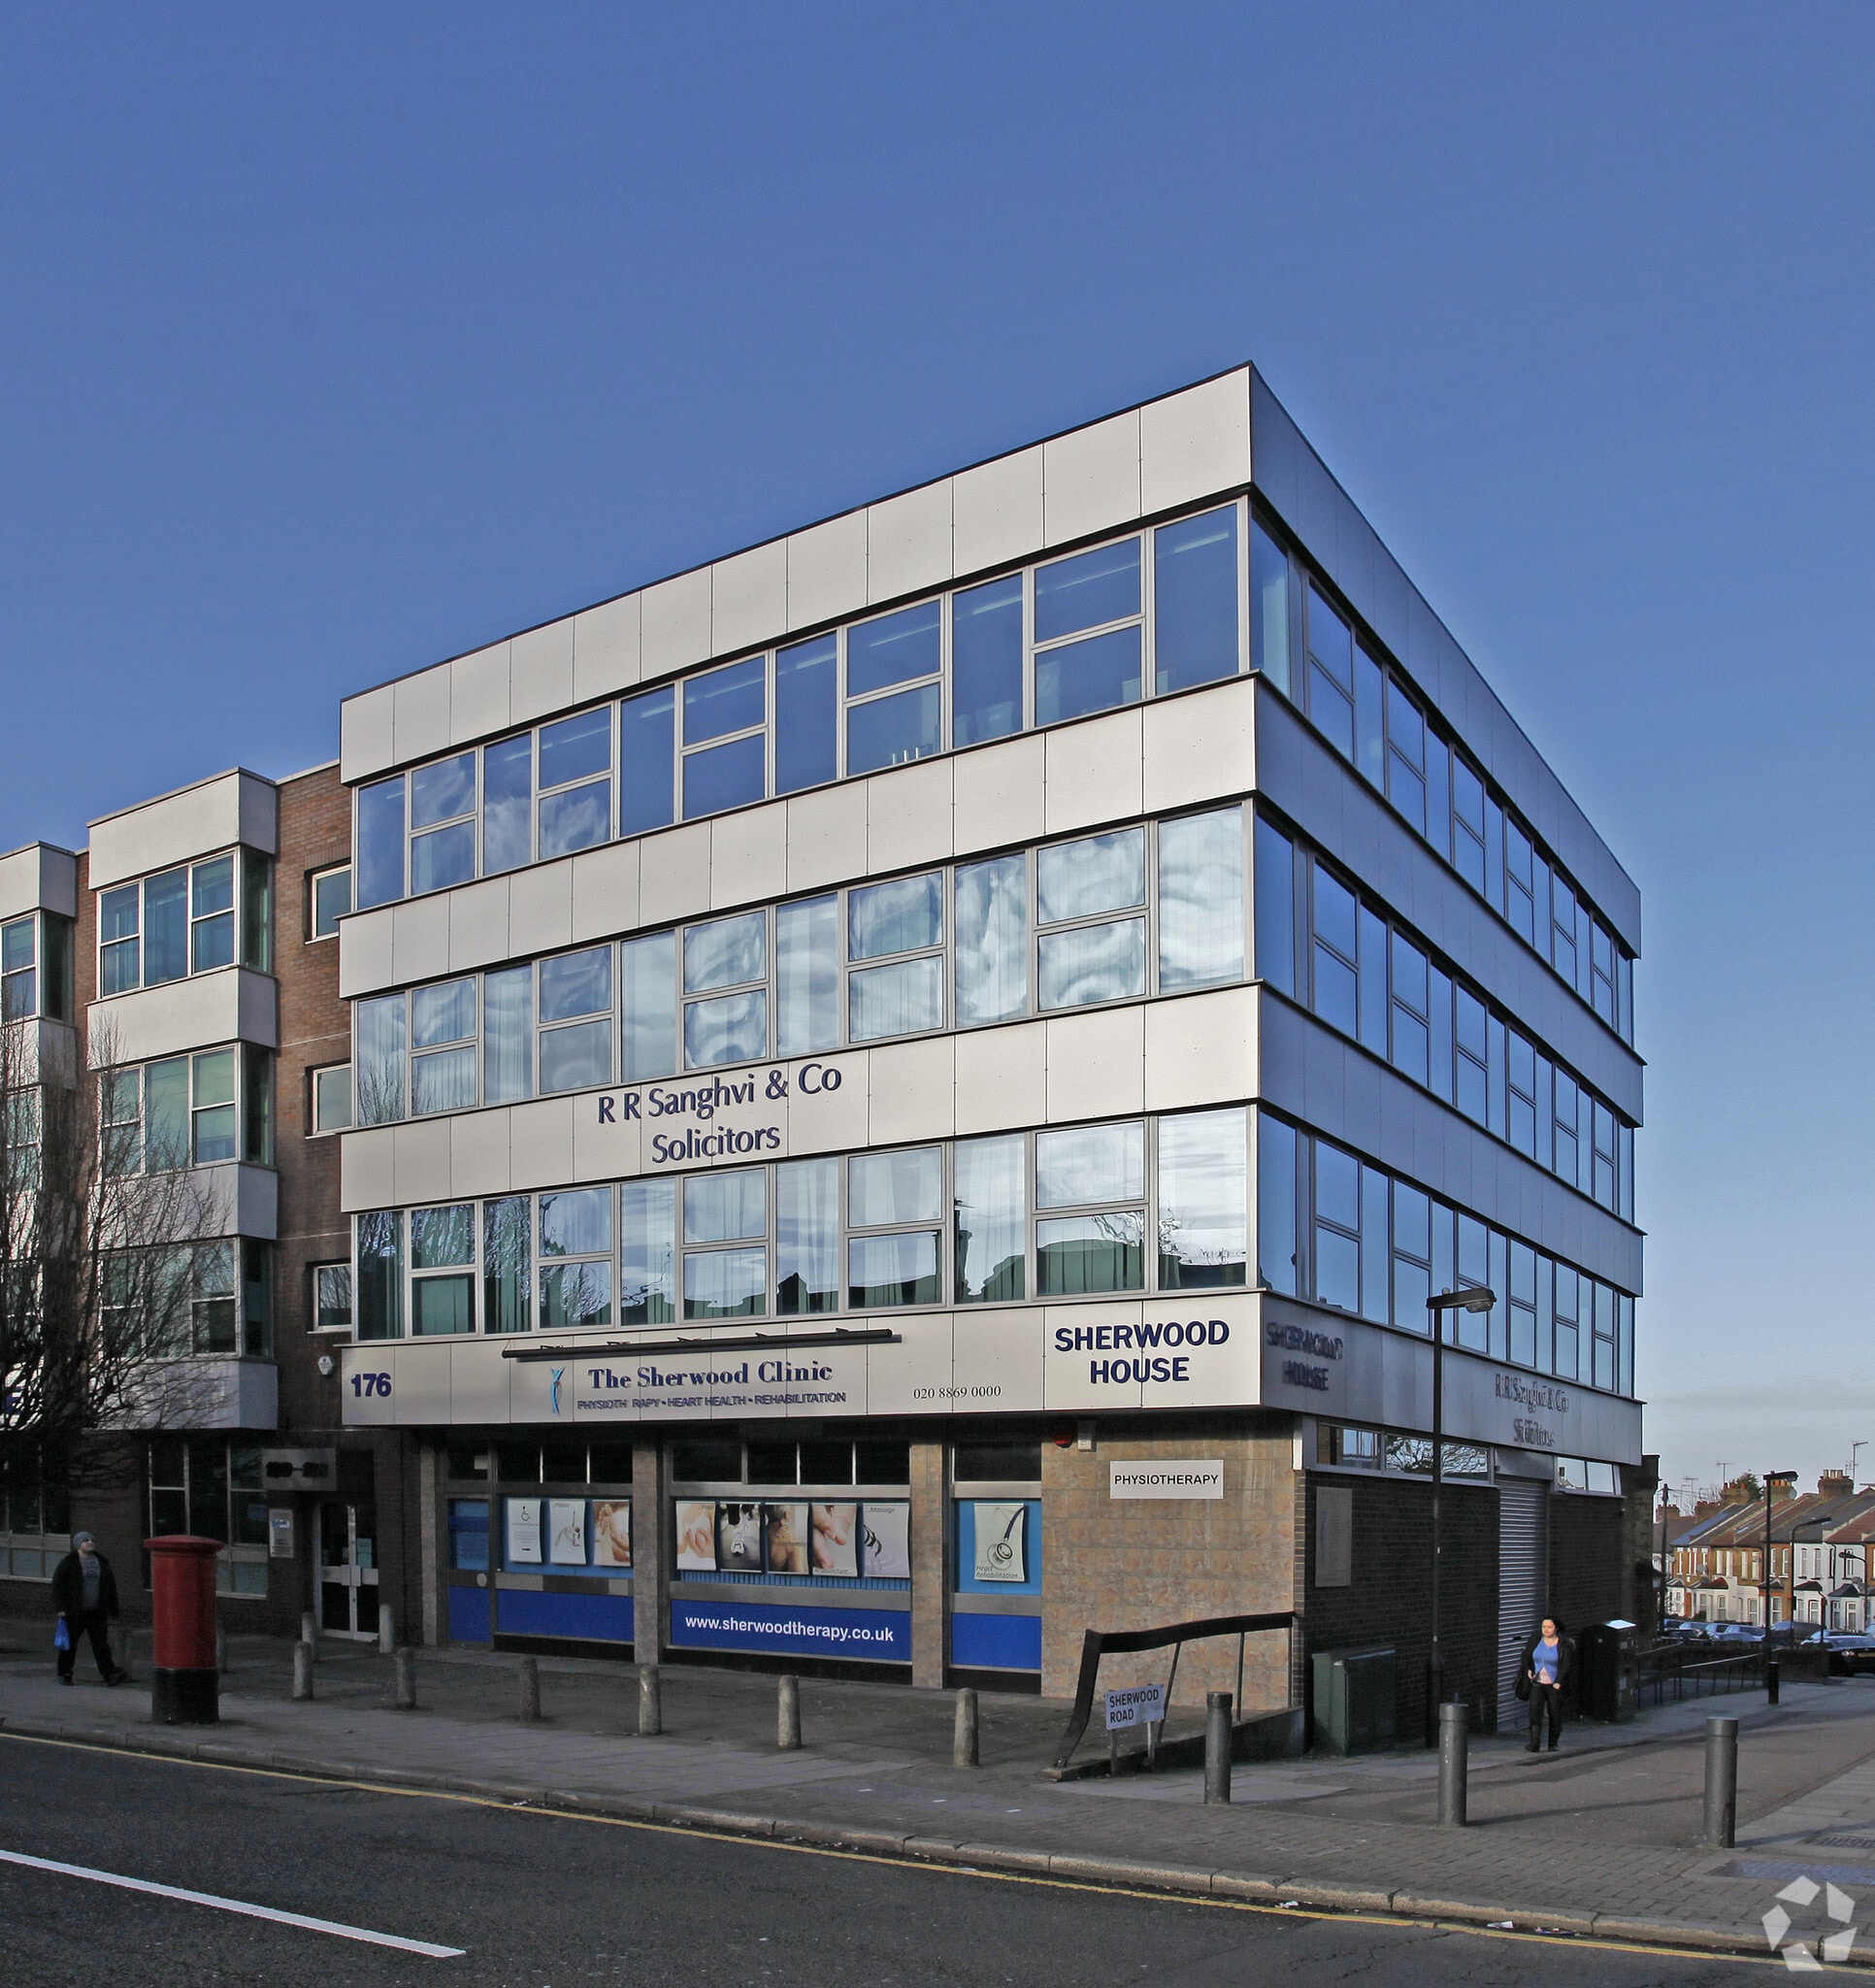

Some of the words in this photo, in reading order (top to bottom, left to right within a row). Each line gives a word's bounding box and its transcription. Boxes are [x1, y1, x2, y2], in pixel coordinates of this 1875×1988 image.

[598, 1096, 615, 1124] R
[623, 1092, 641, 1120] R
[648, 1074, 754, 1119] Sanghvi
[765, 1070, 789, 1100] &
[798, 1063, 842, 1095] Co
[651, 1125, 780, 1164] Solicitors
[1054, 1320, 1230, 1352] SHERWOOD
[588, 1368, 632, 1389] The
[637, 1362, 749, 1388] Sherwood
[758, 1360, 833, 1383] Clinic
[1090, 1356, 1190, 1384] HOUSE
[350, 1372, 392, 1397] 176
[913, 1387, 935, 1399] 020
[938, 1386, 968, 1398] 8869
[970, 1385, 1002, 1397] 0000
[667, 1396, 704, 1408] HEART
[705, 1395, 747, 1407] HEALTH
[754, 1392, 847, 1405] REHABILITATION
[1114, 1474, 1219, 1485] PHYSIOTHERAPY
[685, 1616, 894, 1641] www.sherwoodtherapy.co.uk
[1109, 1689, 1159, 1708] SHERWOOD
[1109, 1708, 1135, 1723] ROAD
